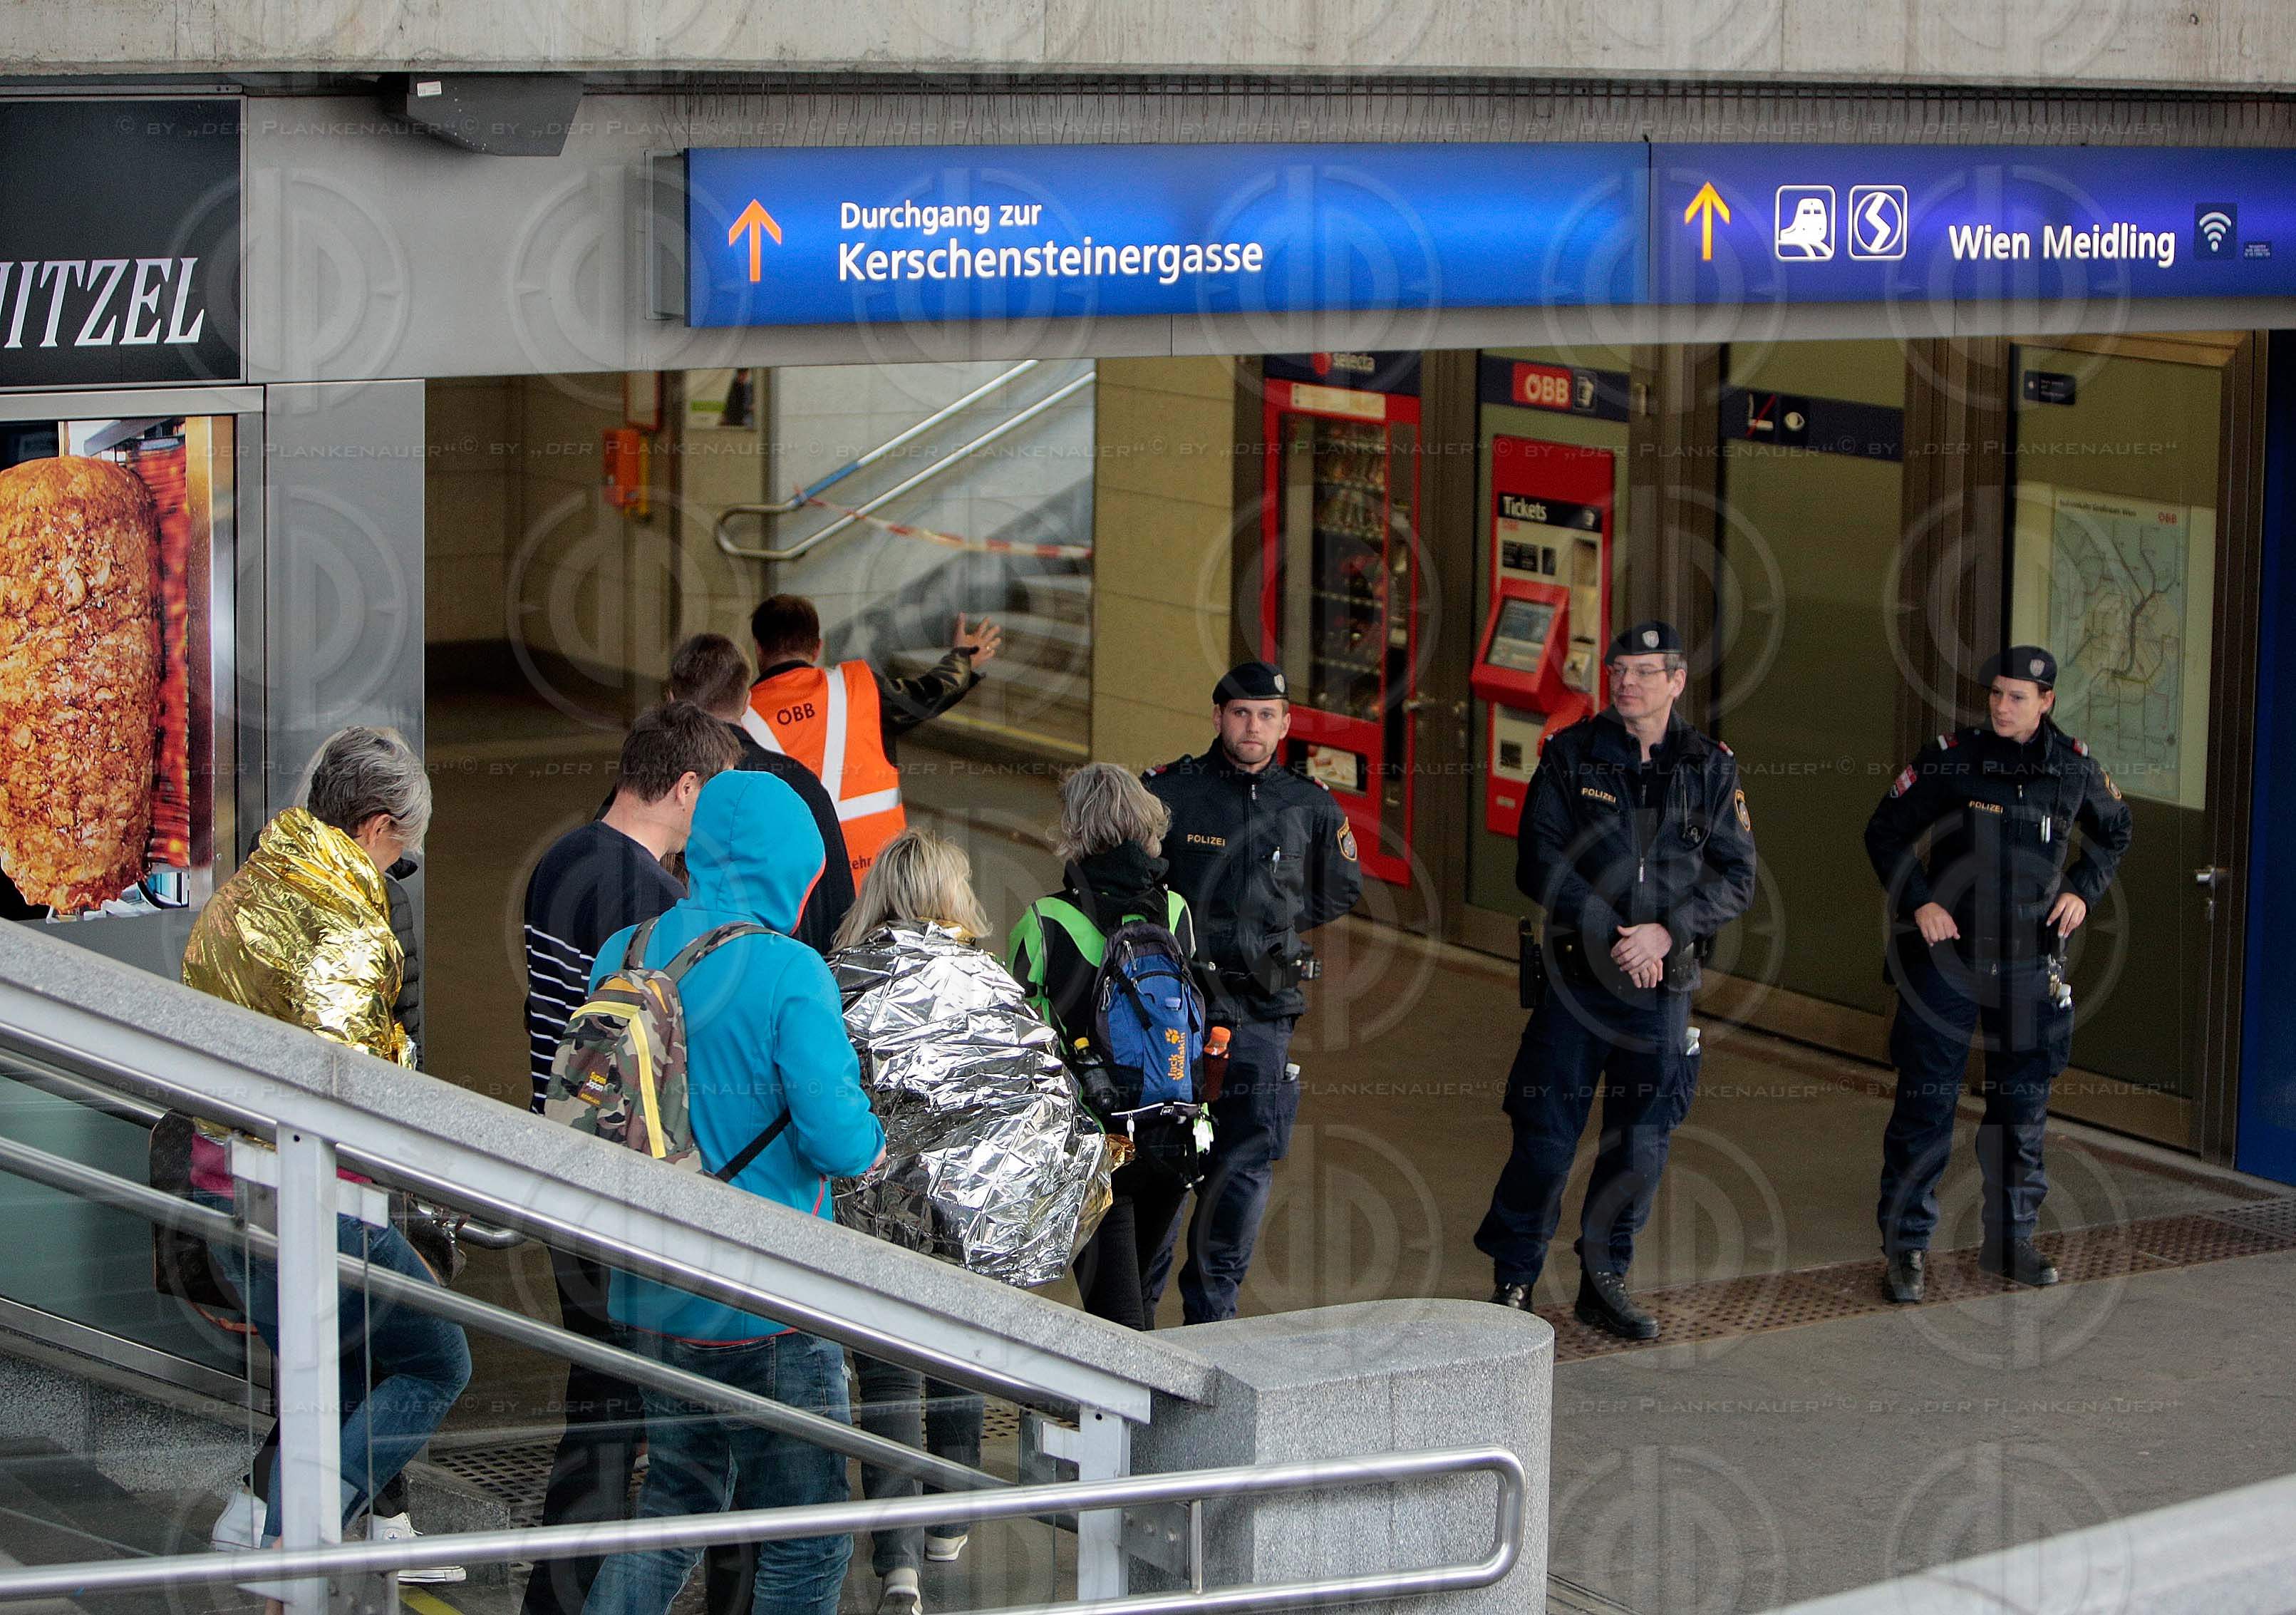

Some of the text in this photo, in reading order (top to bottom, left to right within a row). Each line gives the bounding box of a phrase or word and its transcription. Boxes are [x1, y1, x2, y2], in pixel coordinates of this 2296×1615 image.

[841, 200, 1042, 235] Durchgang zur
[1948, 222, 2176, 269] Wien Meidling
[839, 236, 1263, 284] Kerschensteinergasse
[1504, 495, 1547, 522] Tickets
[1581, 787, 1616, 804] POLIZEI
[1969, 800, 2003, 814] POLIZEI
[1186, 834, 1226, 847] POLIZEI
